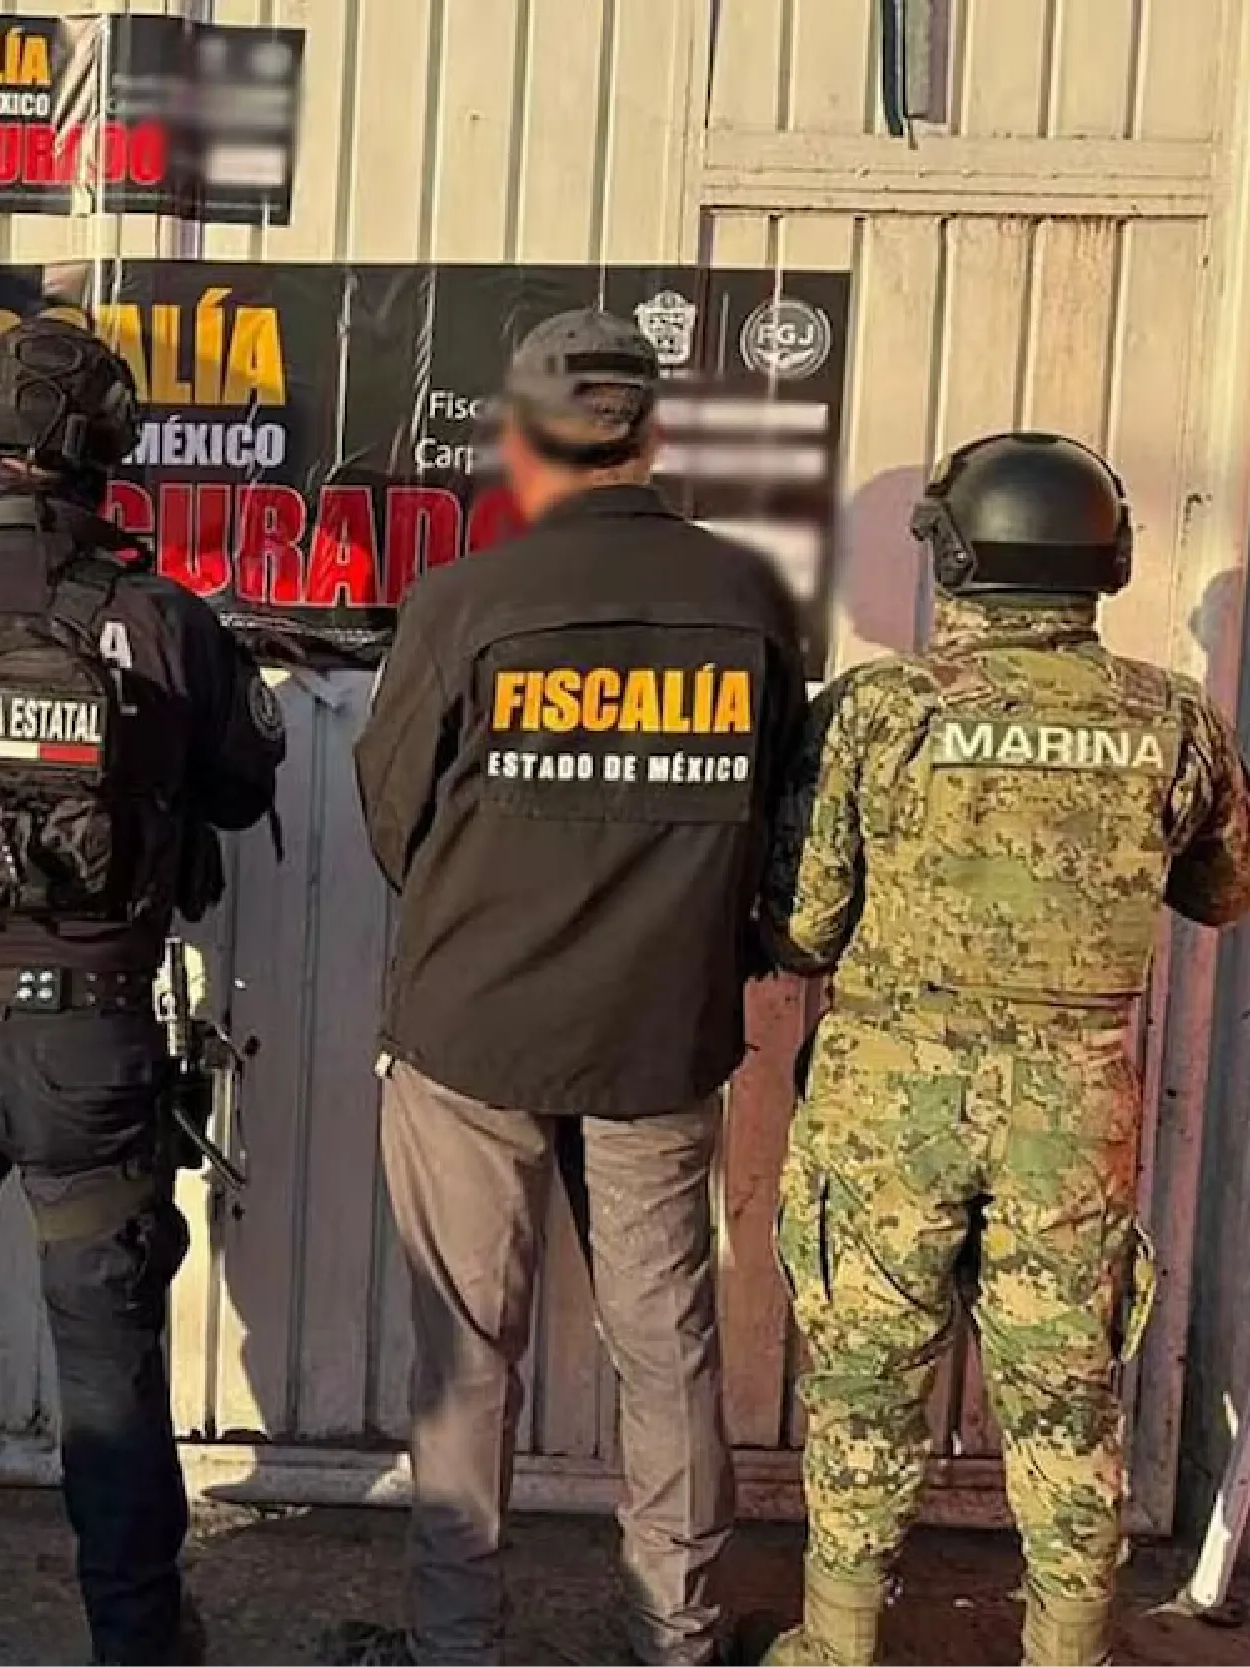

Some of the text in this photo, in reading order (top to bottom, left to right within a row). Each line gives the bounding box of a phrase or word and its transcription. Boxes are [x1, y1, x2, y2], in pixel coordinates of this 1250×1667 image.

[758, 324, 814, 344] FGJ
[492, 662, 751, 733] FISCALÍA
[9, 698, 102, 742] ESTATAL
[487, 751, 749, 783] ESTADO DE MÉXICO
[943, 722, 1163, 768] MARINA
